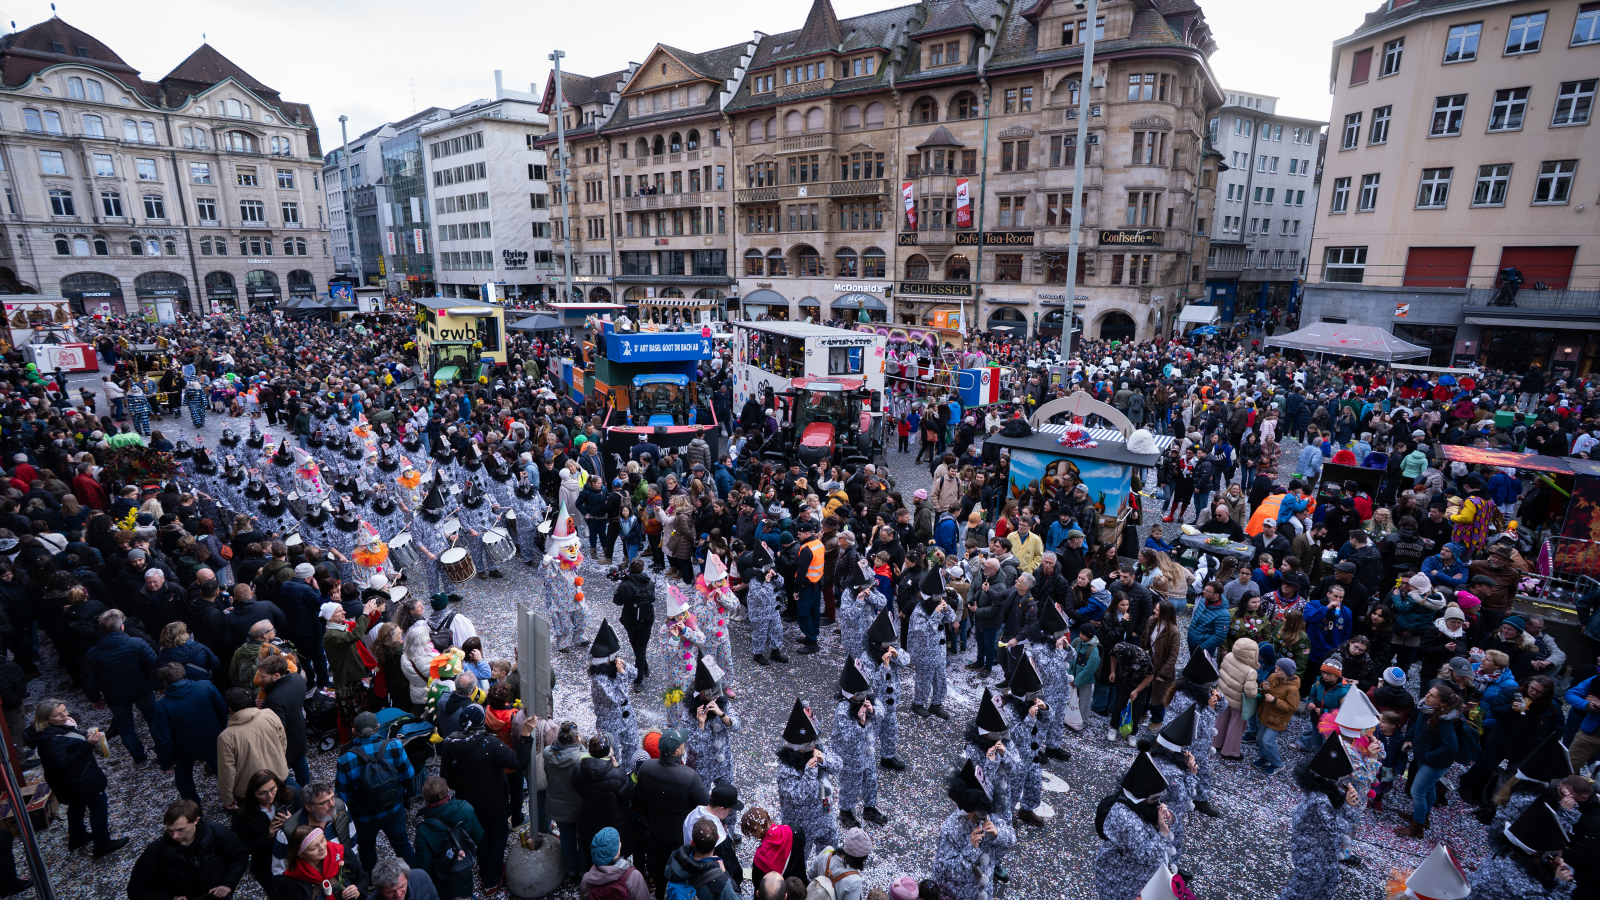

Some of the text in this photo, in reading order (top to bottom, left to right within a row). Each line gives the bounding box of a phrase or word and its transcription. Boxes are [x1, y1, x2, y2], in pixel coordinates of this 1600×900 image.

[45, 226, 93, 234] COIFFURE
[899, 233, 918, 244] Café
[957, 233, 979, 244] Café
[985, 232, 1034, 244] Tea-Room
[1102, 231, 1146, 243] Confiserie
[503, 249, 528, 259] flying
[504, 257, 527, 266] tiger
[834, 283, 883, 293] McDonald's
[903, 284, 968, 295] SCHIESSER
[440, 322, 476, 341] gwb
[640, 344, 648, 352] ART
[649, 344, 662, 352] BASEL
[662, 343, 674, 352] GOOT
[674, 343, 681, 351] DR
[680, 343, 693, 351] BACH
[693, 343, 699, 351] AB
